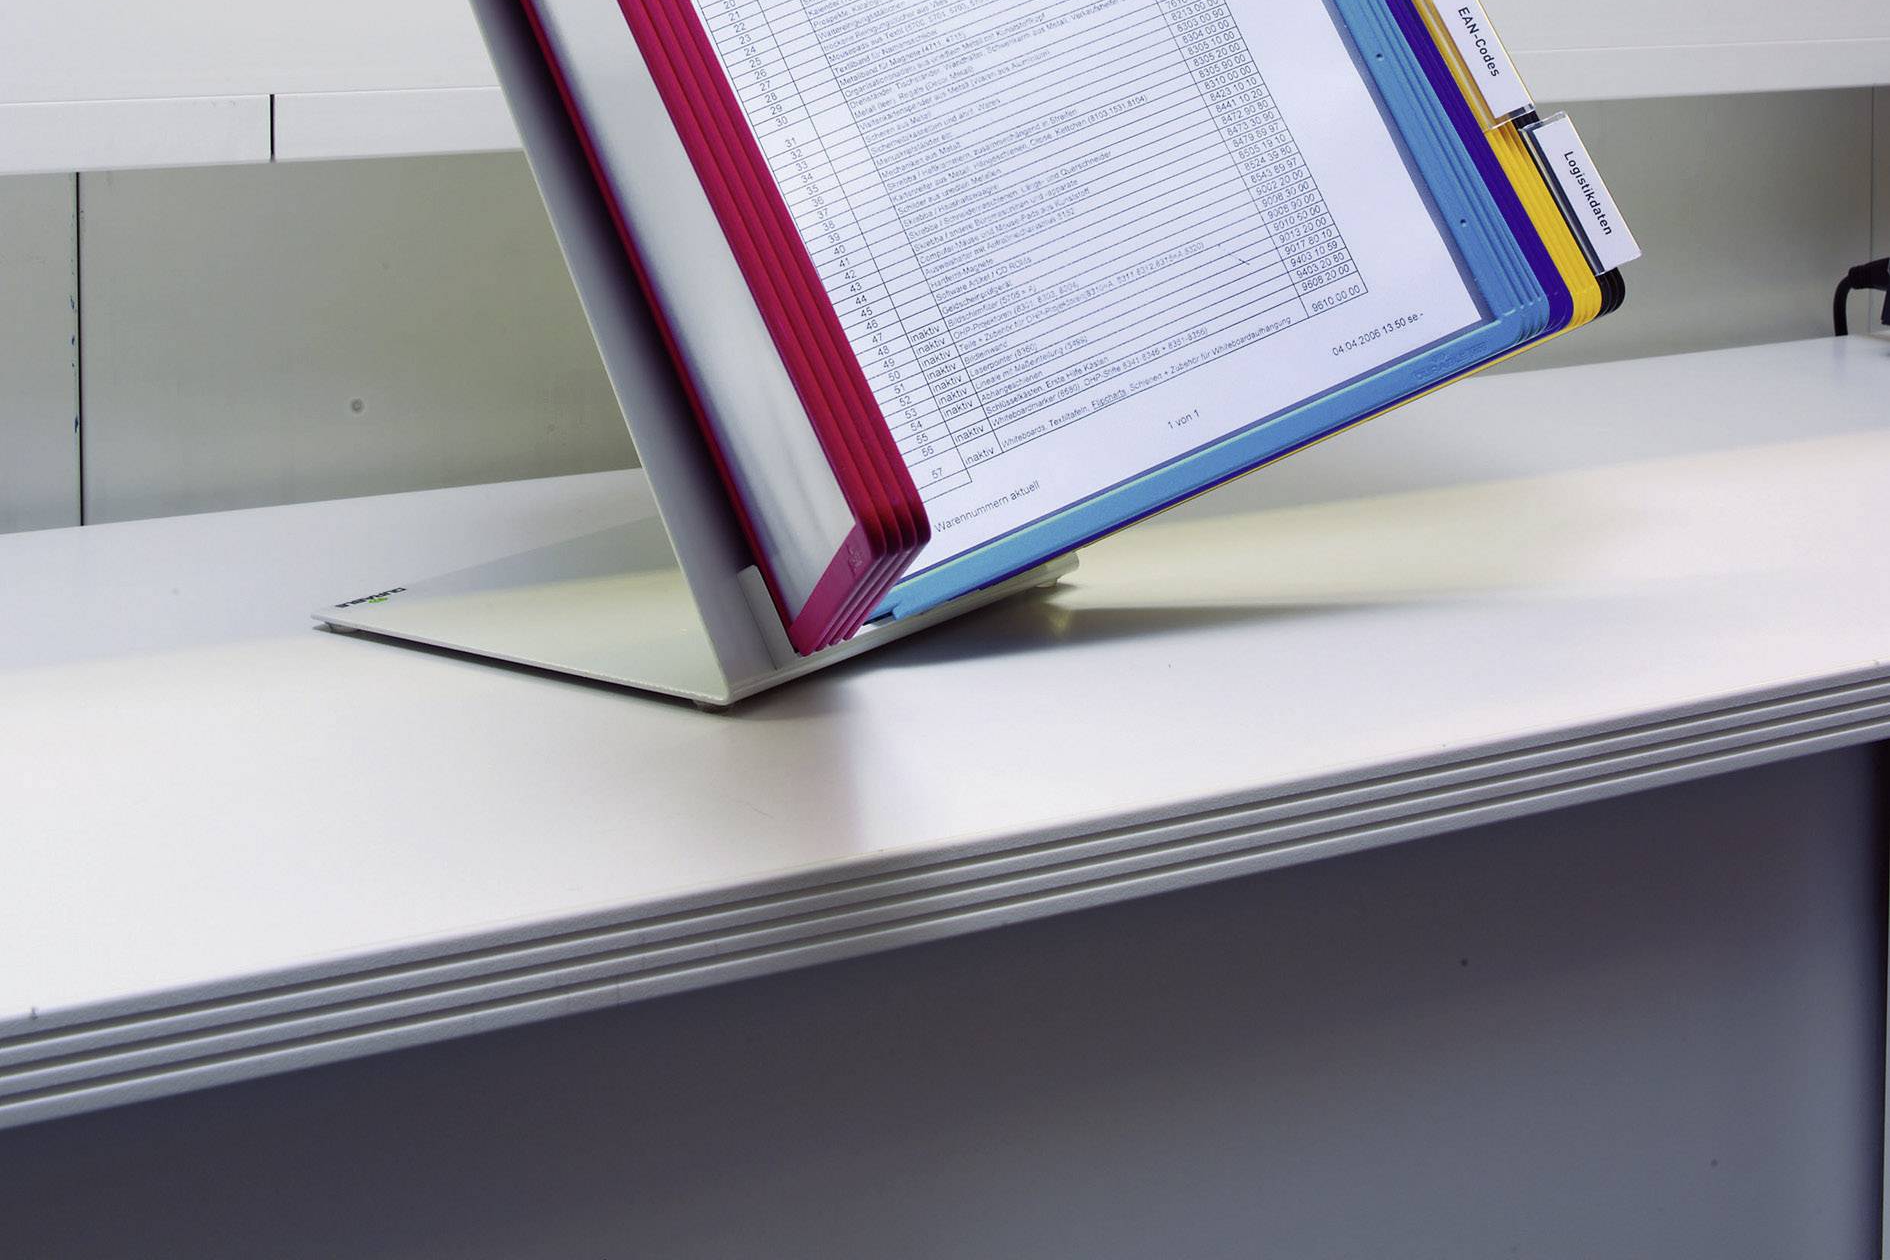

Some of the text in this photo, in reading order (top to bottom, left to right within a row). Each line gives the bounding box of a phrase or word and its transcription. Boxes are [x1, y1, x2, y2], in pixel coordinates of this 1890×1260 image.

[1211, 35, 1223, 45] 10
[1223, 30, 1235, 42] 00
[1457, 6, 1499, 76] EAN-Codes
[1215, 47, 1228, 58] 20
[1228, 42, 1241, 53] 00
[1221, 59, 1234, 70] 90
[1234, 54, 1246, 64] 00
[1227, 70, 1239, 81] 00
[1239, 65, 1252, 76] 00
[1233, 82, 1245, 92] 10
[1245, 76, 1257, 86] 10
[1239, 93, 1251, 103] 10
[1250, 88, 1263, 99] 20
[1249, 116, 1262, 127] 30
[1262, 111, 1275, 122] 90
[1563, 150, 1612, 235] Logistikdaten
[1302, 222, 1314, 234] 20
[1315, 216, 1327, 228] 00
[1314, 246, 1326, 256] 10
[1326, 240, 1338, 251] 59
[1319, 257, 1332, 269] 20
[1332, 251, 1345, 263] 80
[1335, 290, 1348, 302] 00
[1348, 284, 1361, 296] 00
[910, 326, 940, 343] inaktiv
[1331, 328, 1382, 357] 04.04.2006
[918, 337, 945, 353] inaktiv
[921, 350, 951, 367] inaktiv
[926, 363, 956, 380] inaktiv
[932, 375, 962, 392] inaktiv
[938, 388, 967, 405] inaktiv
[943, 400, 973, 417] inaktiv
[1174, 413, 1193, 427] von
[954, 425, 984, 443] inaktiv
[965, 447, 994, 465] inaktiv
[934, 479, 1041, 533] Warennummern aktuell
